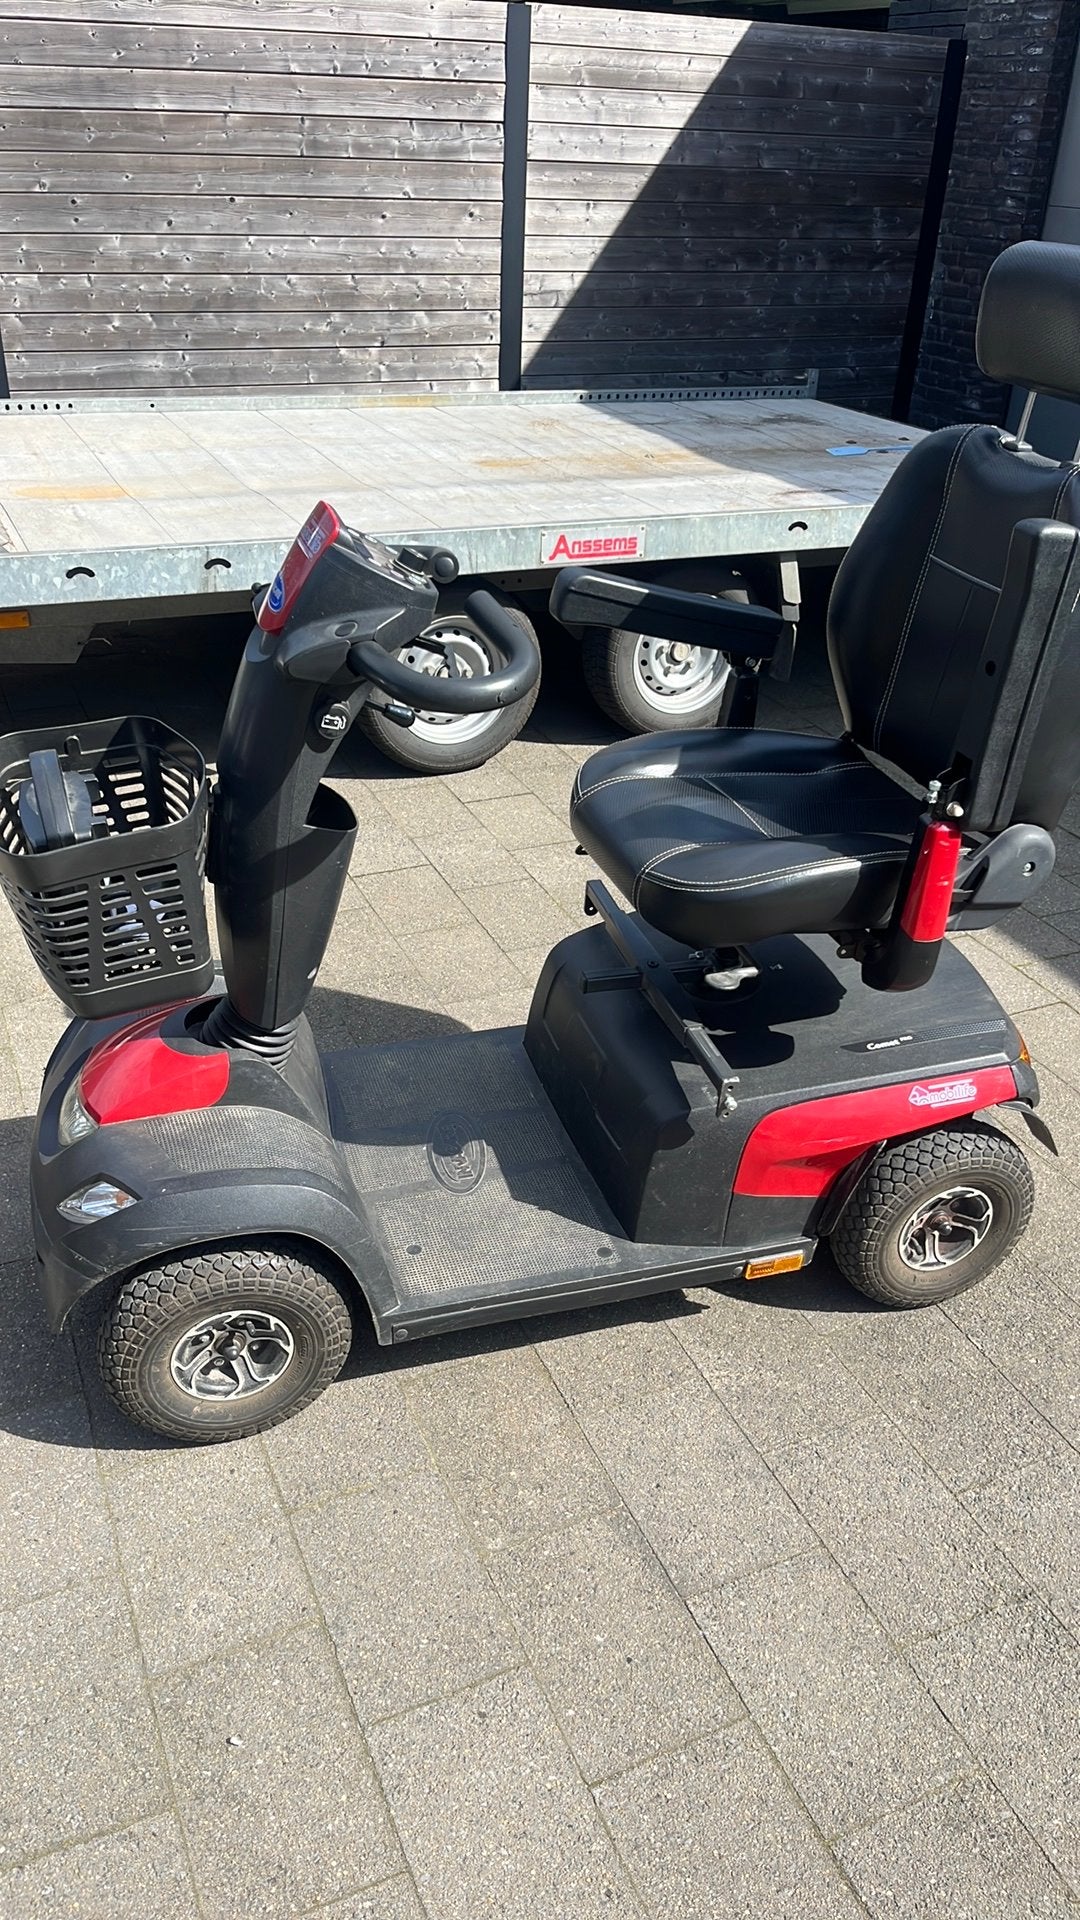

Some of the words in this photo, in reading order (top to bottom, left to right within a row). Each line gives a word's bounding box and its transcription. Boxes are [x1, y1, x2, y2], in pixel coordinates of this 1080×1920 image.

[549, 534, 638, 561] Anssems
[866, 1039, 901, 1051] Comet
[929, 1083, 977, 1104] mobilife
